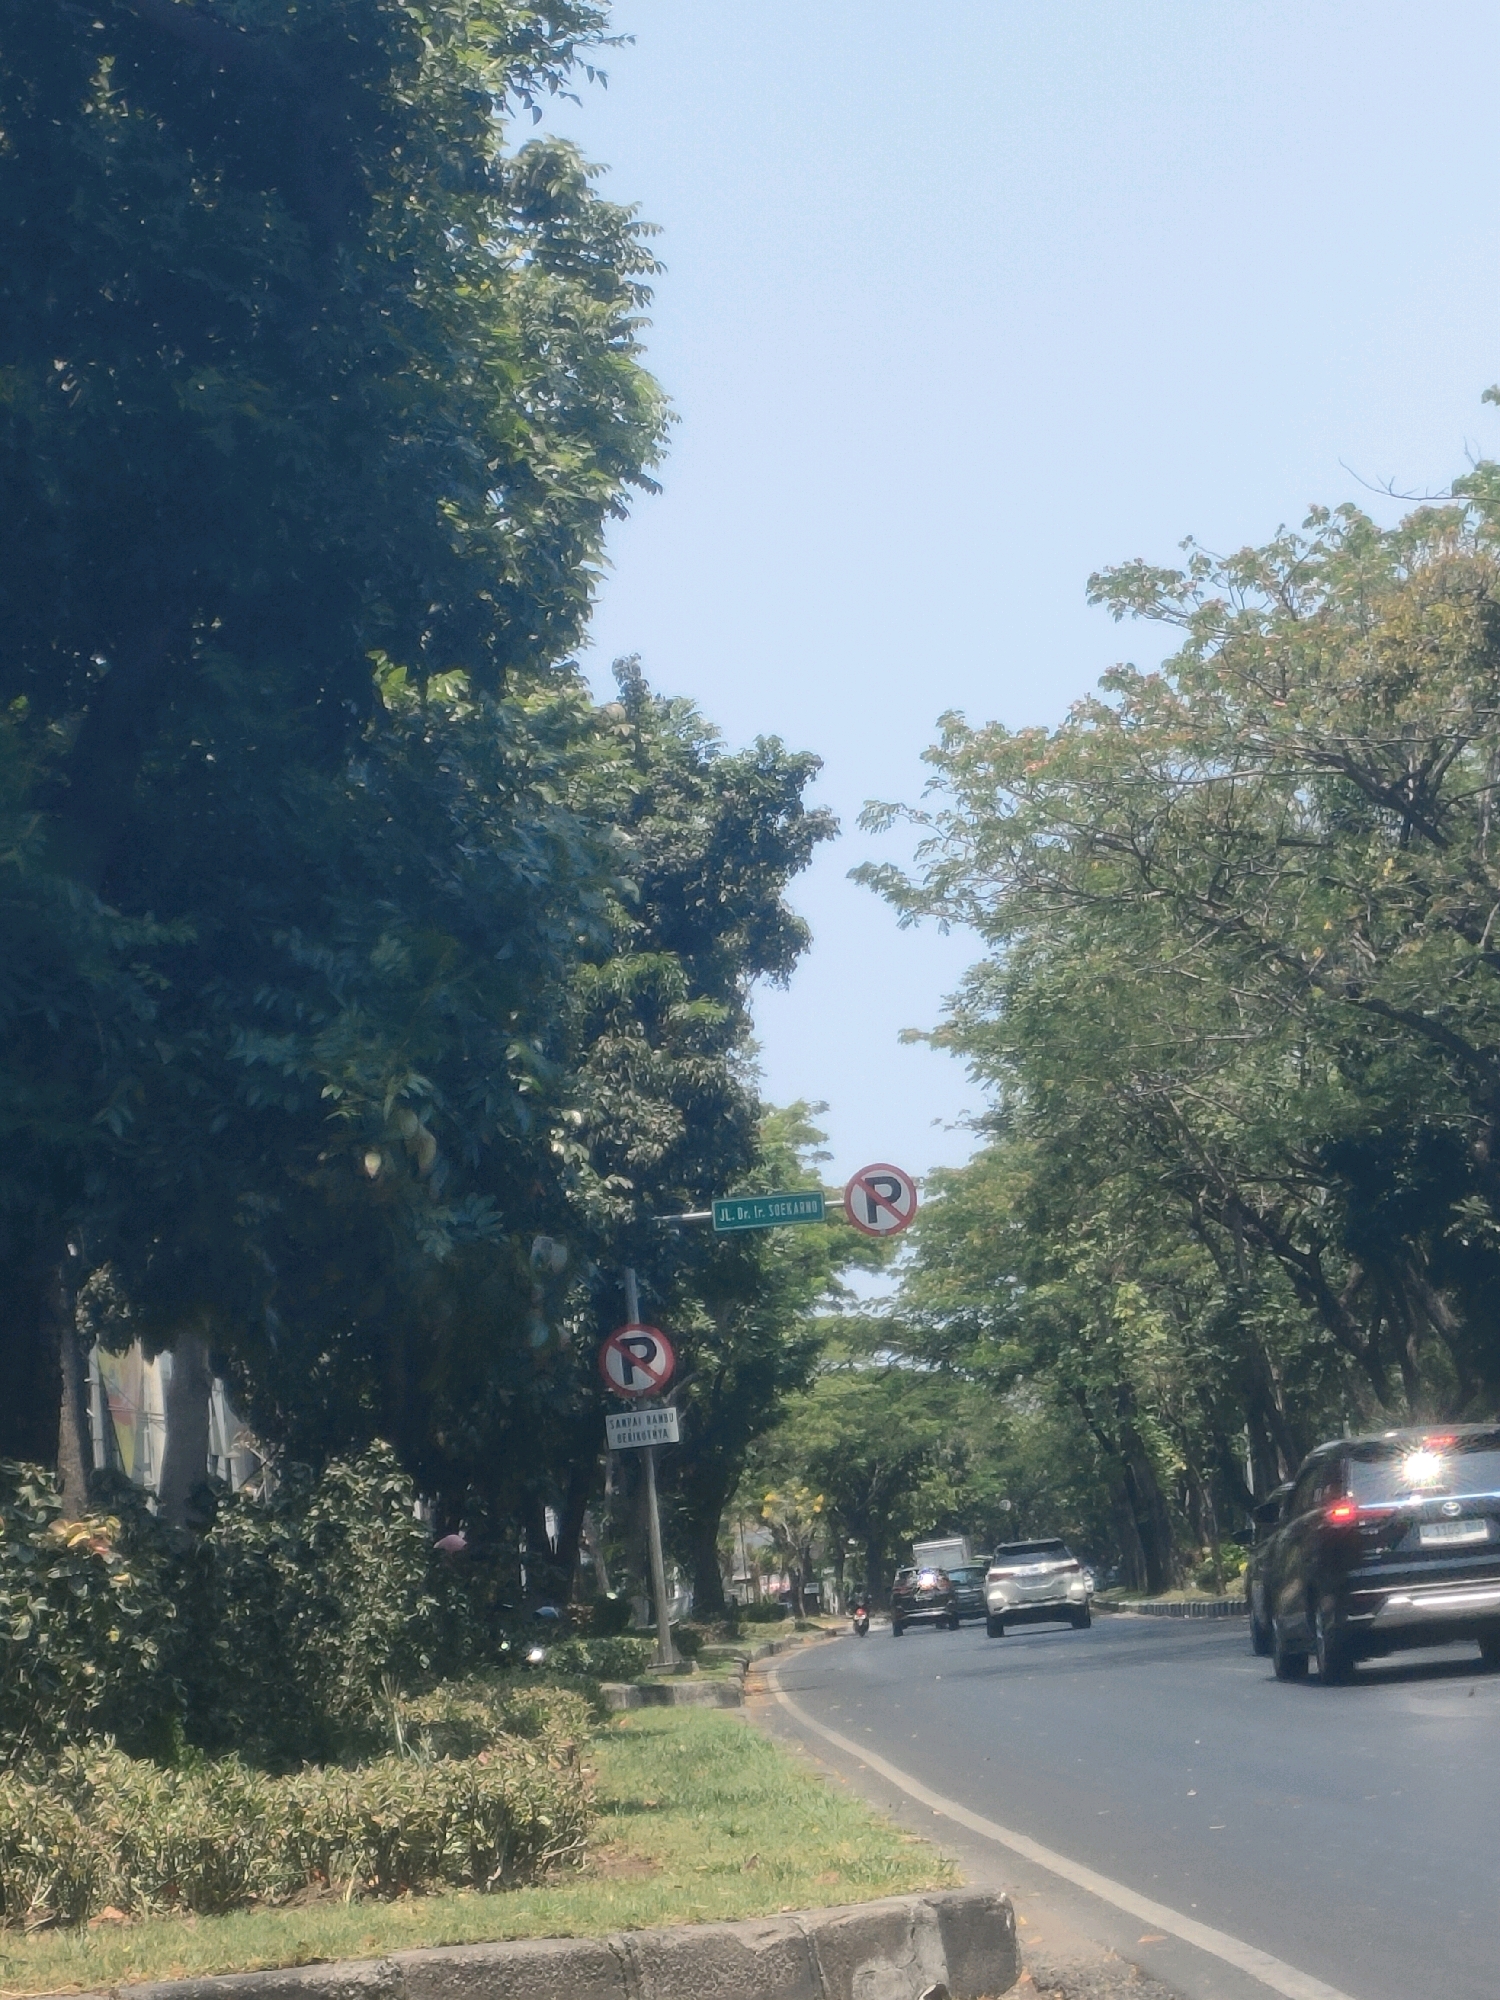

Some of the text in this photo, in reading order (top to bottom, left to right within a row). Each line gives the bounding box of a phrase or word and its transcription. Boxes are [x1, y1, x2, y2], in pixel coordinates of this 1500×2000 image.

[719, 1200, 818, 1222] JL. Dr. Ir. SOEKARNO
[609, 1412, 674, 1429] SAMPAI RAMBU
[617, 1429, 669, 1443] BERIKUTNYA
